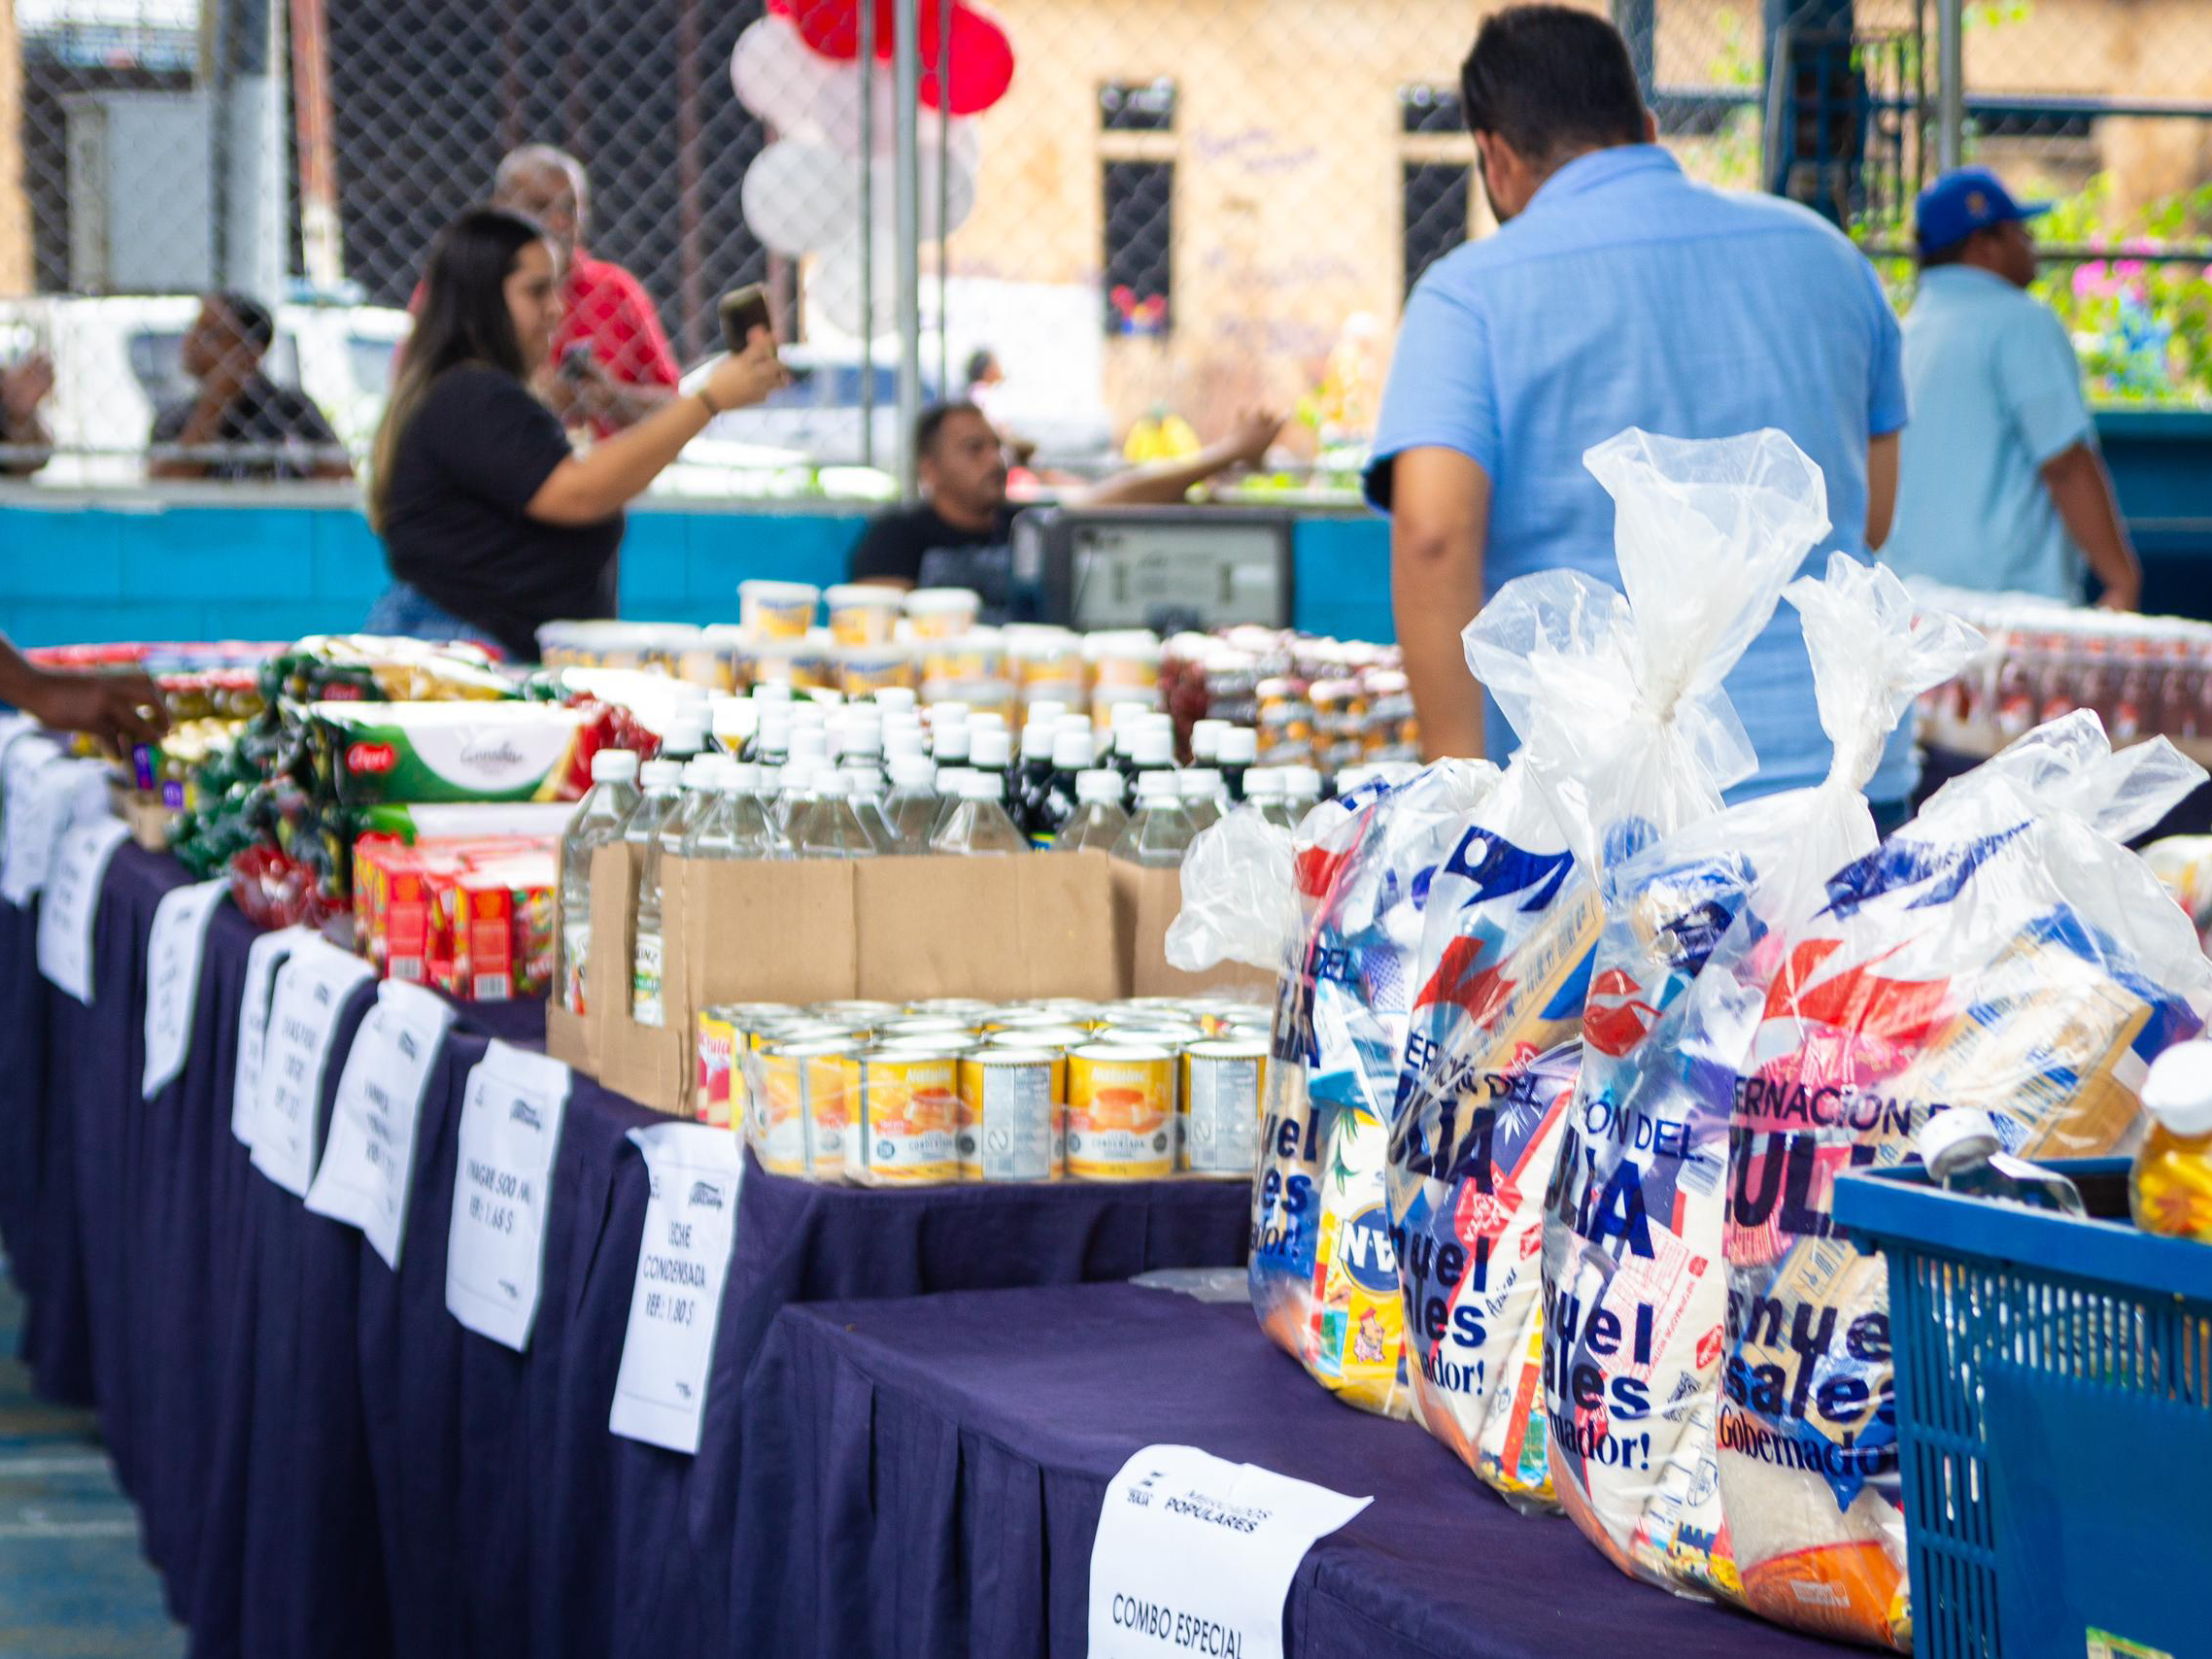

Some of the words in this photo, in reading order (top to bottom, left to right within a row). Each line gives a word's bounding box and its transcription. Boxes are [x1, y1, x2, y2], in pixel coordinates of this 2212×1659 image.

[1635, 1113, 1704, 1162] DEL
[643, 1255, 705, 1290] CONDENSADA
[1165, 1497, 1259, 1534] POPULARES
[1112, 1593, 1172, 1640] COMBO
[1174, 1612, 1243, 1659] ESPECIAL
